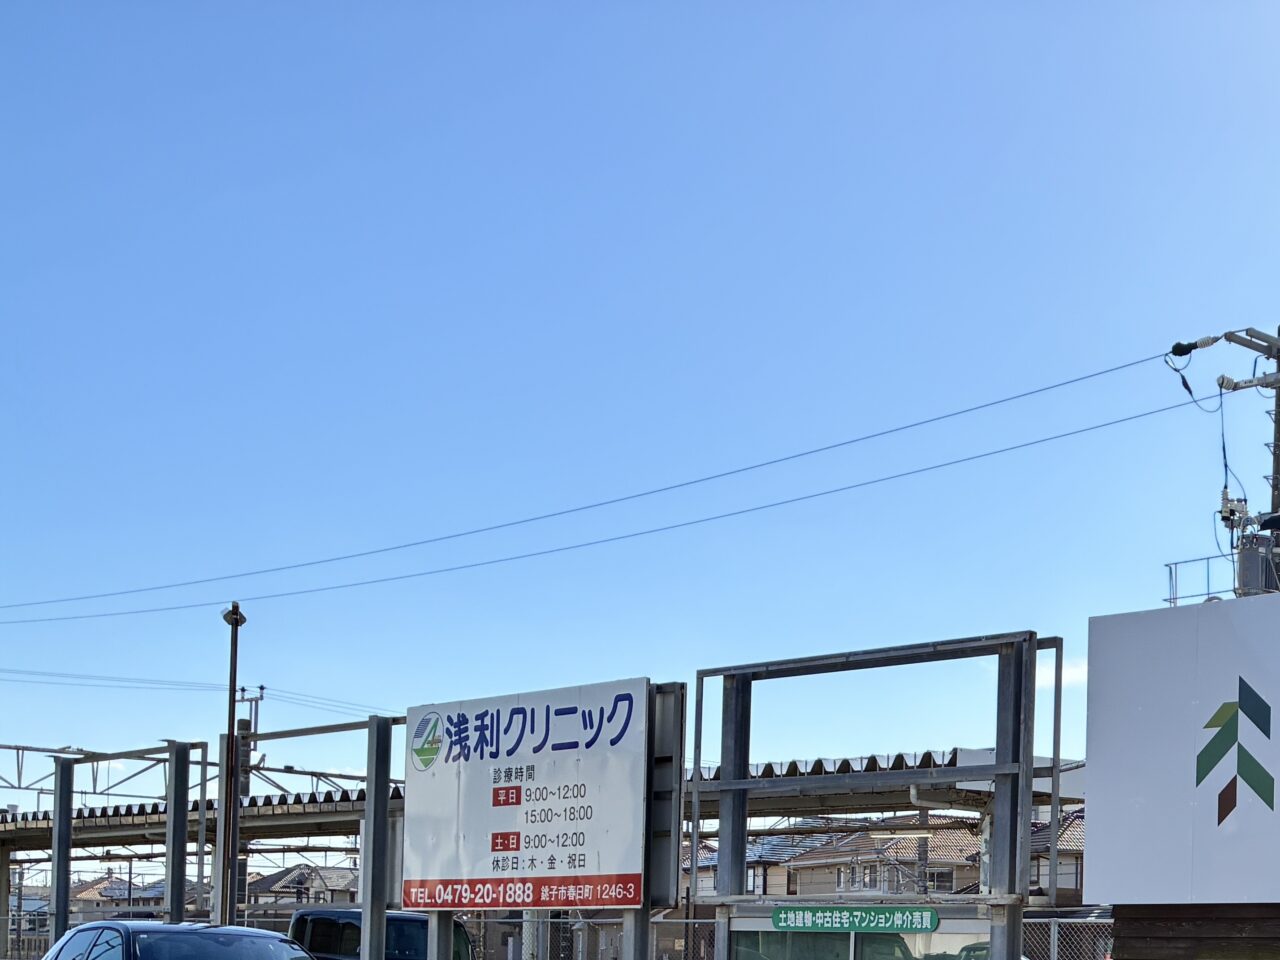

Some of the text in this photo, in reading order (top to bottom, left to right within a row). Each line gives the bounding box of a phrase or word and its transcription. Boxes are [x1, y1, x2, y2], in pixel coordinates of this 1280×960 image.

[445, 693, 634, 763] 浅利クリニック
[493, 765, 535, 784] 診療時間
[498, 789, 517, 804] 平日
